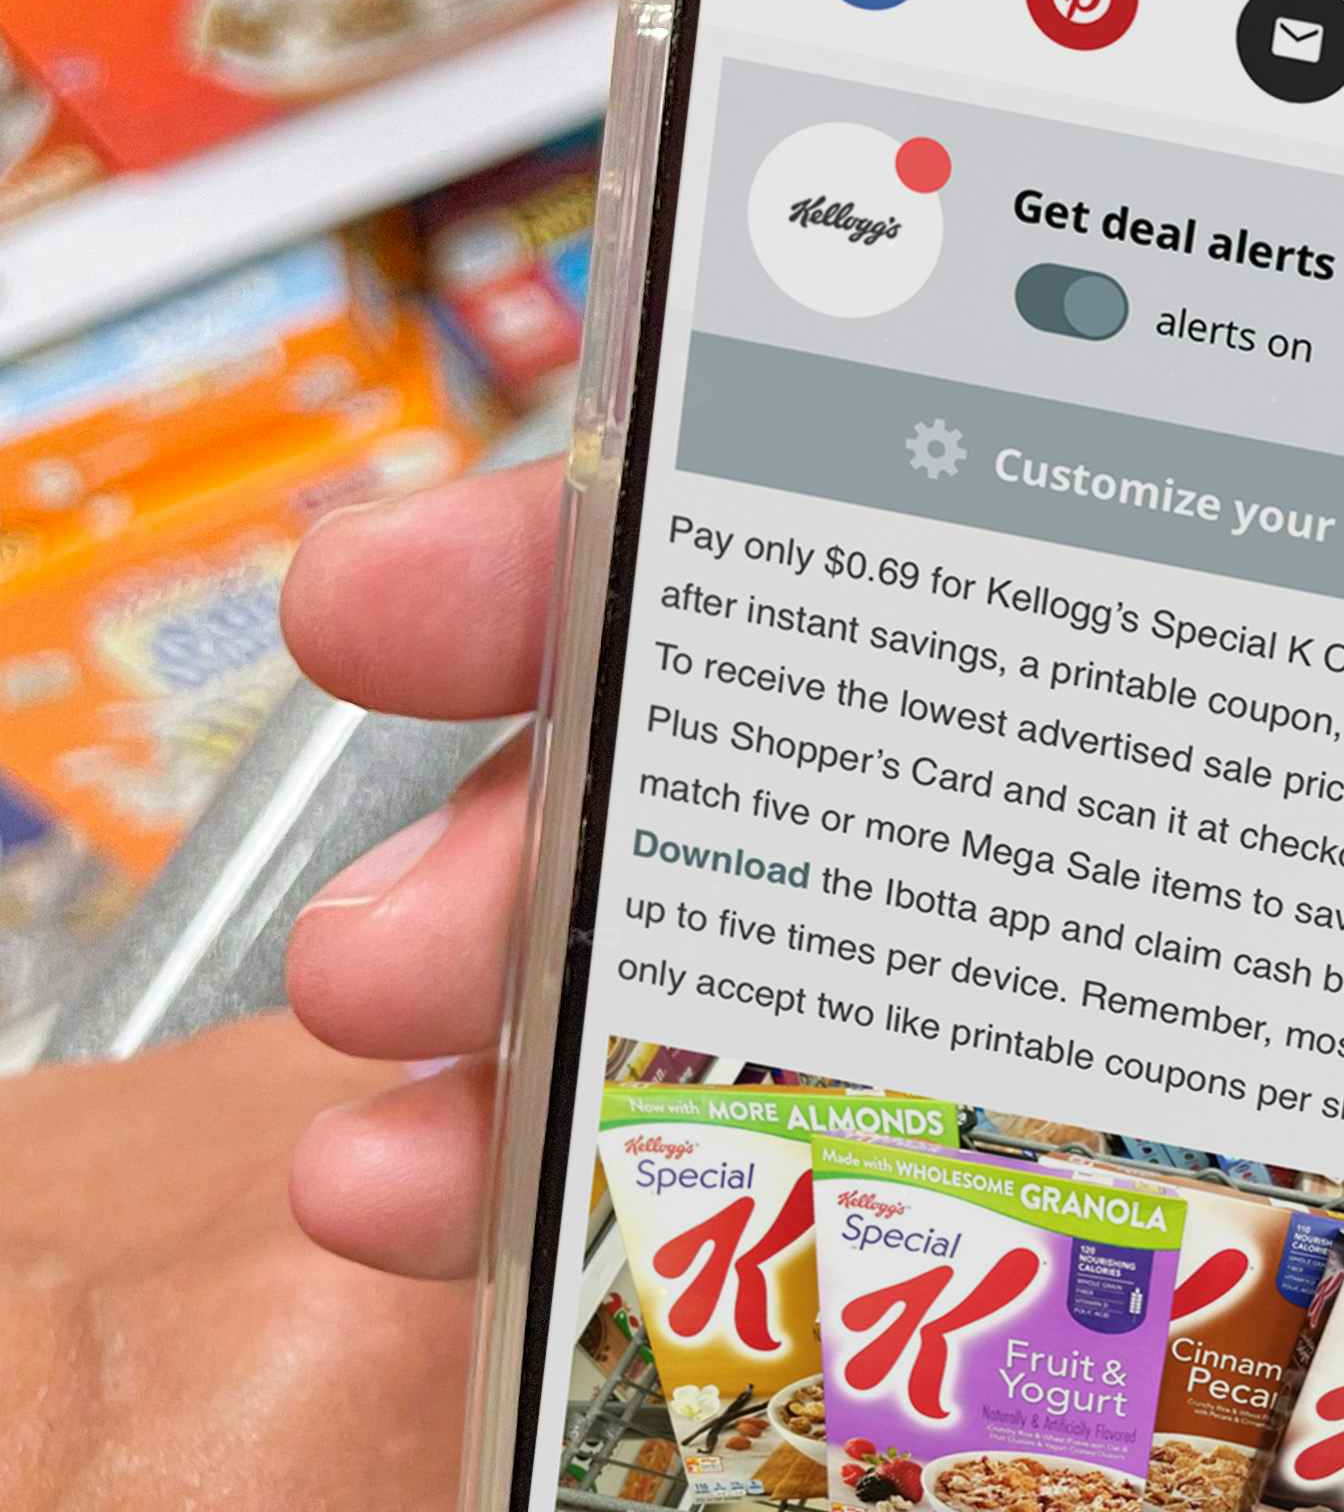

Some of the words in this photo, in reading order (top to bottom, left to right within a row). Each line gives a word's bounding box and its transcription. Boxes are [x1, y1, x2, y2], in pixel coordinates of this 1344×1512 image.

[788, 194, 903, 246] Kellogg's
[1012, 188, 1090, 236] Get
[1100, 204, 1197, 255] deal
[1206, 227, 1337, 281] alerts
[1155, 307, 1257, 352] alerts
[1266, 335, 1314, 363] on
[994, 445, 1222, 522] Customize
[1231, 499, 1336, 544] your
[669, 514, 735, 561] Pay
[744, 537, 815, 576] only
[824, 544, 920, 590] $0.69
[931, 566, 977, 601] for
[986, 576, 1139, 635] Kellogg's
[1151, 609, 1277, 660] Special
[1287, 635, 1315, 667] K
[661, 582, 739, 619] after
[747, 595, 860, 644] instant
[869, 626, 1006, 677] savings,
[1049, 660, 1197, 709] printable
[1208, 692, 1341, 743] coupon,
[655, 641, 693, 675] To
[704, 658, 826, 701] receive
[837, 679, 889, 714] the
[900, 689, 1008, 737] lowest
[1017, 719, 1194, 773] advertised
[1203, 756, 1272, 788] sale
[647, 704, 718, 745] Plus
[730, 721, 900, 780] Shopper's
[911, 756, 994, 798] Card
[1003, 781, 1068, 813] and
[1077, 795, 1156, 830] scan
[639, 773, 741, 813] match
[752, 788, 810, 826] five
[865, 817, 950, 853] more
[961, 829, 1055, 877] Mega
[1066, 850, 1141, 890] Sale
[1151, 866, 1242, 911] items
[633, 828, 811, 889] Download
[821, 867, 873, 902] the
[885, 878, 977, 923] Ibotta
[988, 905, 1051, 942] app
[1061, 920, 1125, 951] and
[1134, 930, 1222, 970] claim
[1233, 953, 1312, 988] cash
[719, 908, 776, 946] five
[787, 923, 876, 965] times
[886, 948, 942, 977] per
[951, 956, 1066, 1003] device.
[1081, 979, 1271, 1048] Remember,
[617, 958, 687, 996] only
[695, 974, 807, 1017] accept
[885, 1003, 940, 1040] like
[950, 1023, 1094, 1070] printable
[1105, 1054, 1247, 1101] coupons
[1256, 1083, 1313, 1113] per
[624, 1135, 695, 1159] Kellogg's
[629, 1097, 664, 1112] Now
[668, 1100, 700, 1114] with
[709, 1101, 779, 1121] MORE
[786, 1104, 944, 1136] ALMONDS
[636, 1159, 755, 1195] Special
[823, 1149, 860, 1167] Made
[864, 1157, 893, 1172] with
[896, 1160, 1014, 1197] WHOLESOME
[1020, 1184, 1167, 1232] GRANOLA
[837, 1189, 907, 1219] Kellogg's
[652, 1167, 815, 1352] K
[840, 1213, 962, 1259] Special
[1078, 1263, 1121, 1277] CALORIES
[840, 1247, 1040, 1420] K
[1007, 1339, 1095, 1382] Fruit
[1102, 1359, 1128, 1386] &
[999, 1368, 1128, 1417] Yogurt
